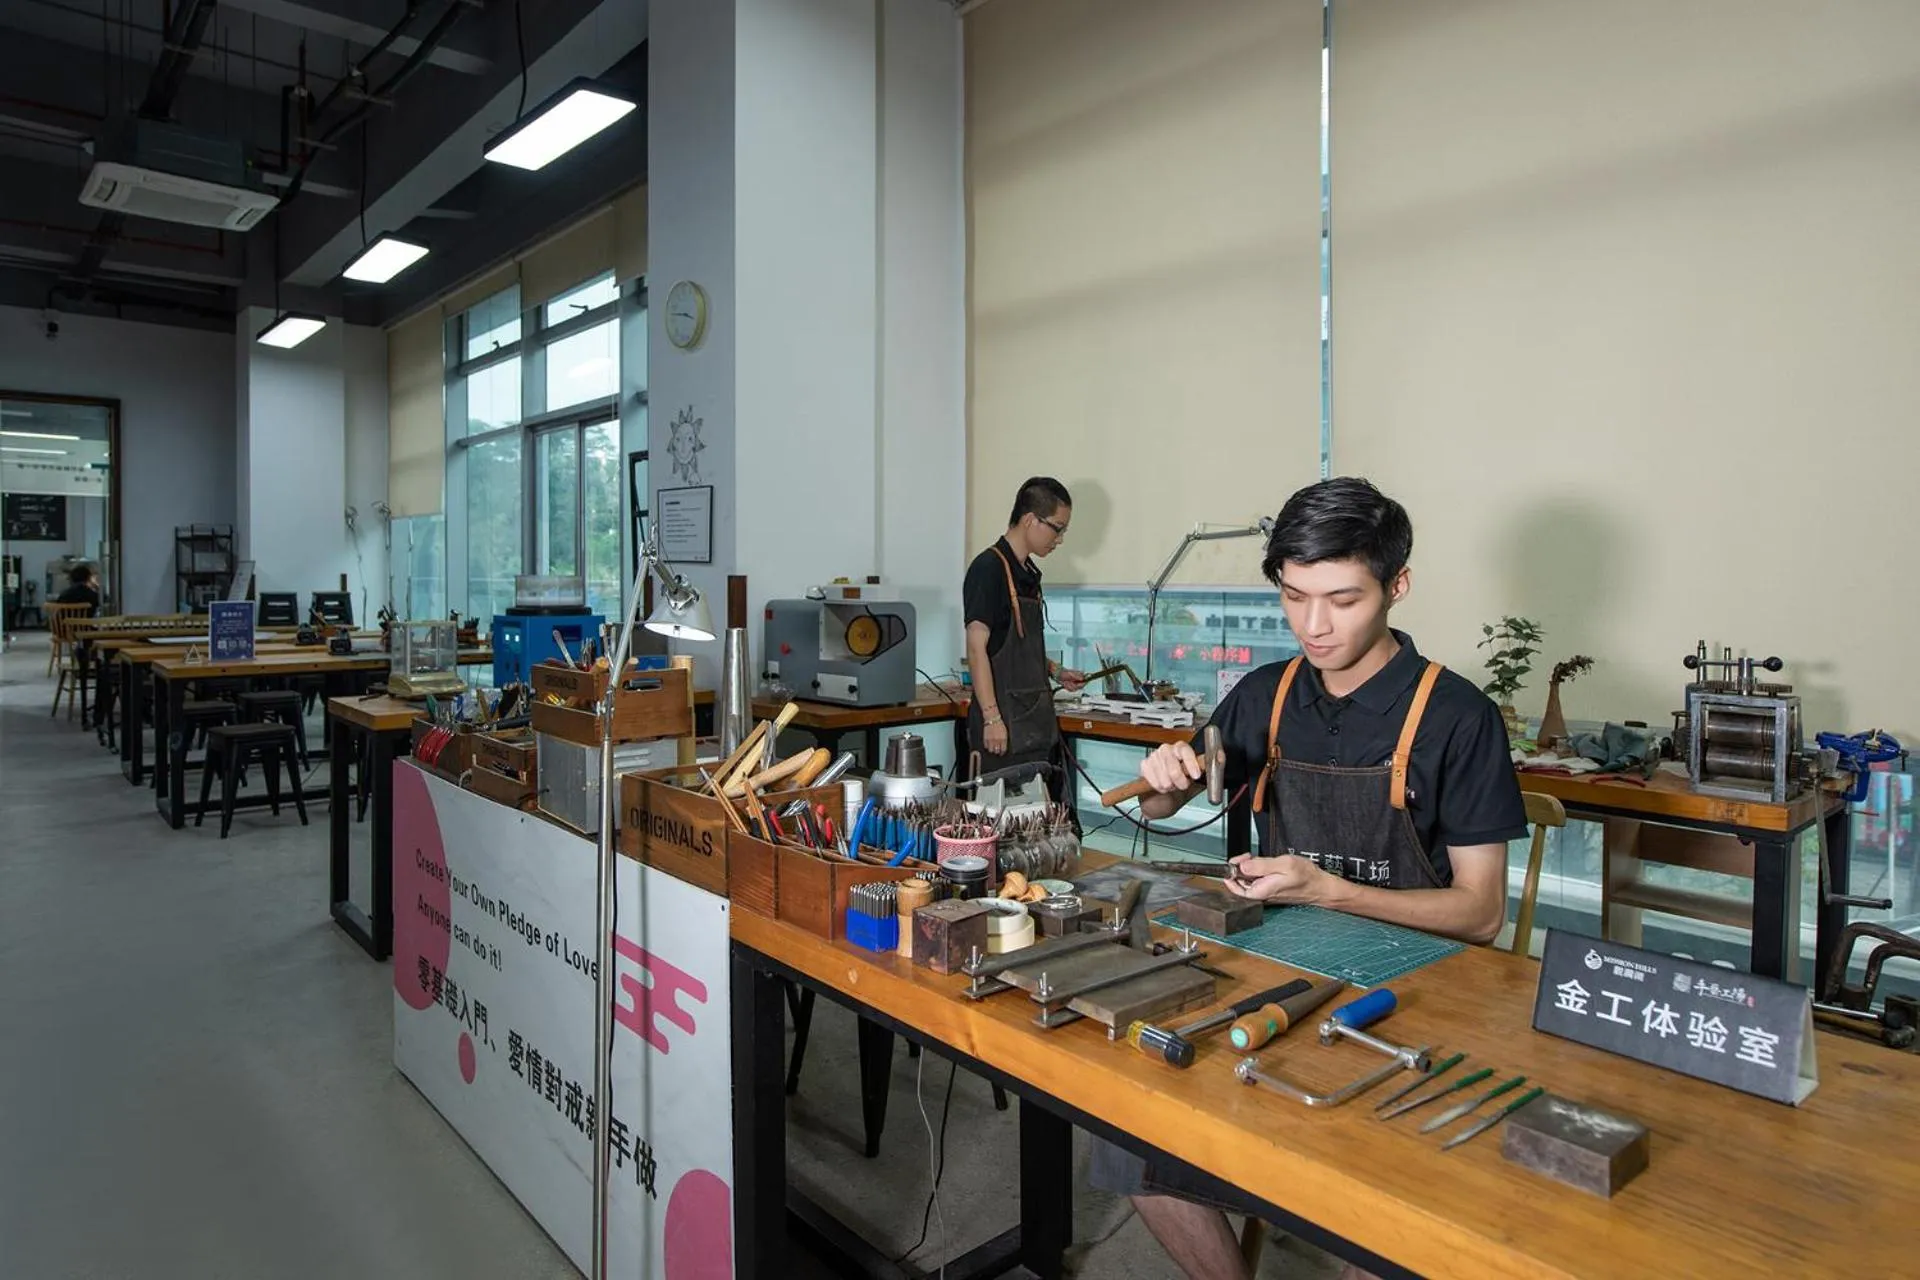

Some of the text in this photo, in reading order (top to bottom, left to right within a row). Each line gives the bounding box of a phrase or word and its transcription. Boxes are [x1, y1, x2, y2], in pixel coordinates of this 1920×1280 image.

[630, 807, 714, 858] ORIGINALS
[415, 848, 598, 981] Create Your Own Pledge of Love
[417, 894, 502, 972] Anyone can do it!
[1554, 978, 1780, 1069] 金工体验室
